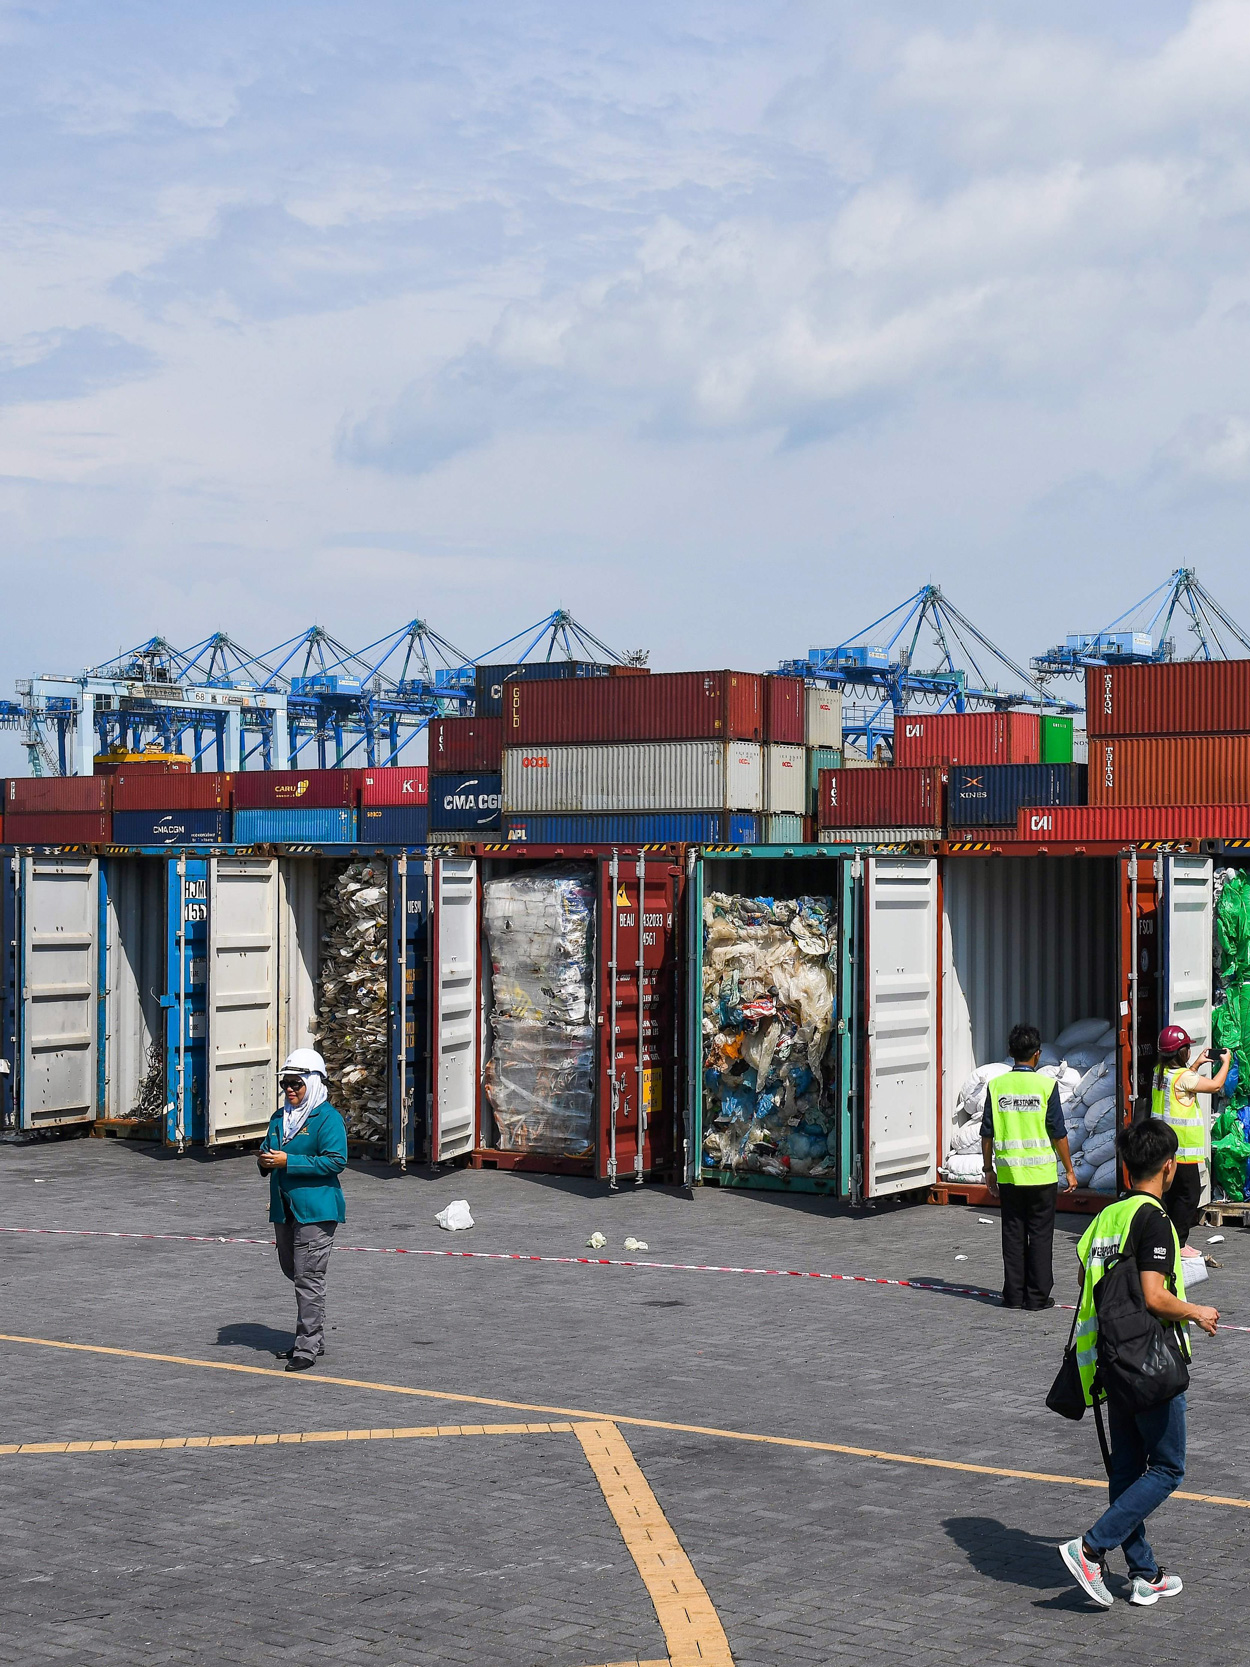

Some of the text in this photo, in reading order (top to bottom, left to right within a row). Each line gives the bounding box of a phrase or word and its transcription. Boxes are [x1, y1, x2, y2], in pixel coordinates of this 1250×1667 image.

[195, 692, 205, 701] 68
[491, 685, 502, 699] C
[1104, 674, 1112, 714] TRITON
[905, 724, 924, 738] CAI
[444, 795, 476, 809] CMA
[1030, 816, 1052, 831] CAI
[508, 830, 527, 840] APL
[620, 913, 635, 927] BEAU
